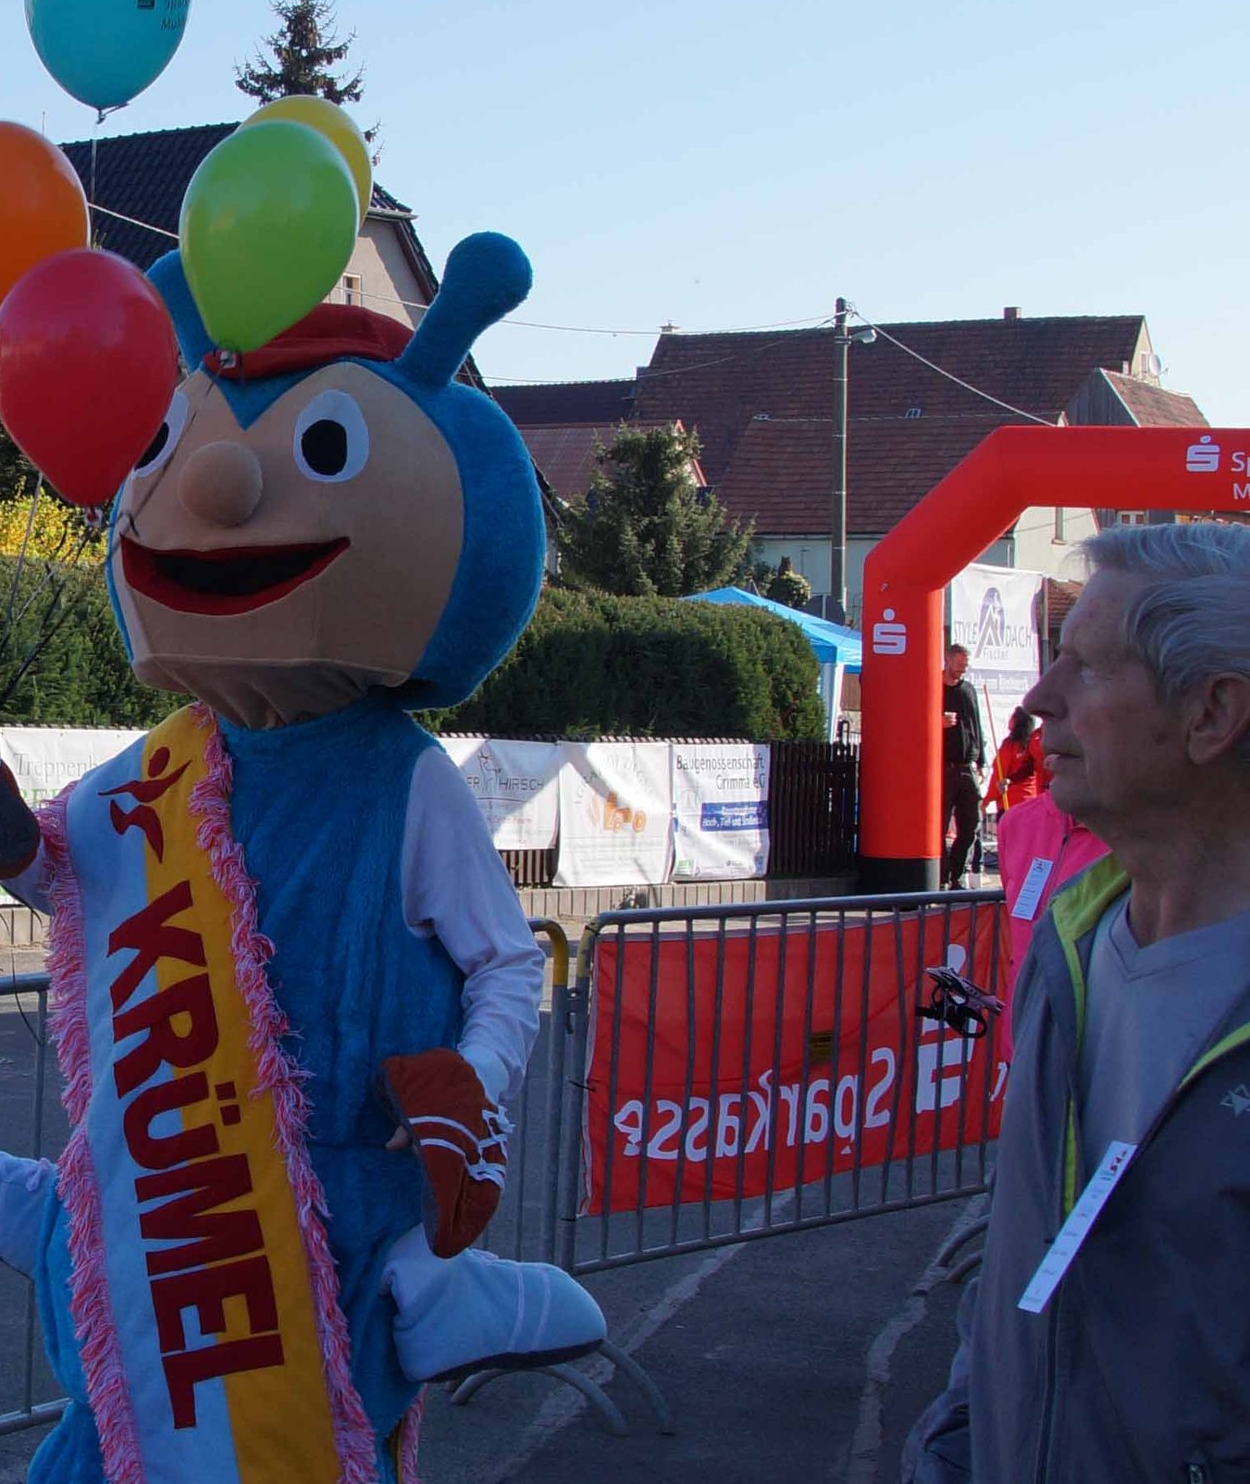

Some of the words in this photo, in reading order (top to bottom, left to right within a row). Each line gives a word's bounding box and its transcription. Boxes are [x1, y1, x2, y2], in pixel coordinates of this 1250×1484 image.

[676, 753, 765, 774] Baugenossenschaft
[500, 780, 545, 791] HIRSCH
[716, 774, 750, 790] Grimma
[108, 879, 285, 1430] KRÜMEL
